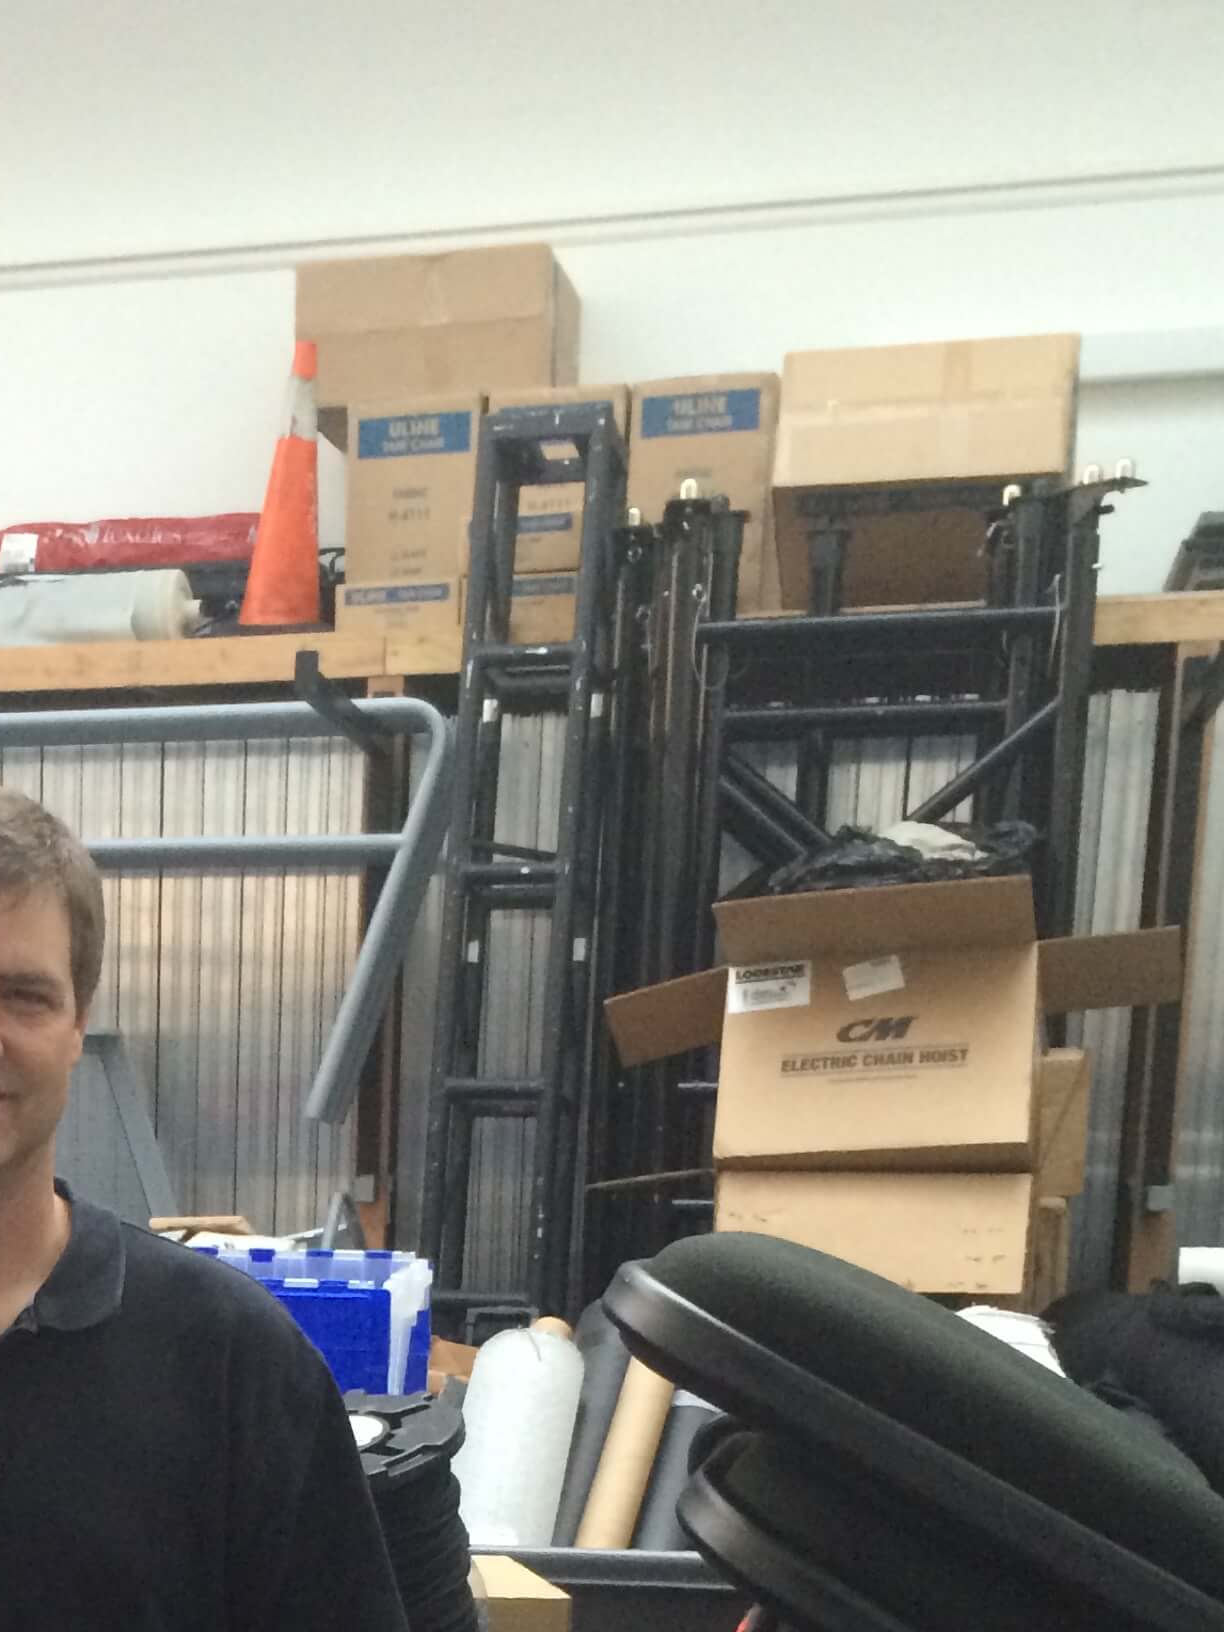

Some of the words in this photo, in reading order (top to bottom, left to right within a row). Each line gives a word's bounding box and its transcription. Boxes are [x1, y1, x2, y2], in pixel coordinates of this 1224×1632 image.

[836, 1016, 918, 1043] CM
[781, 1054, 859, 1073] ELECTRIC
[862, 1050, 914, 1068] CHAIN
[919, 1048, 969, 1064] HOIST
